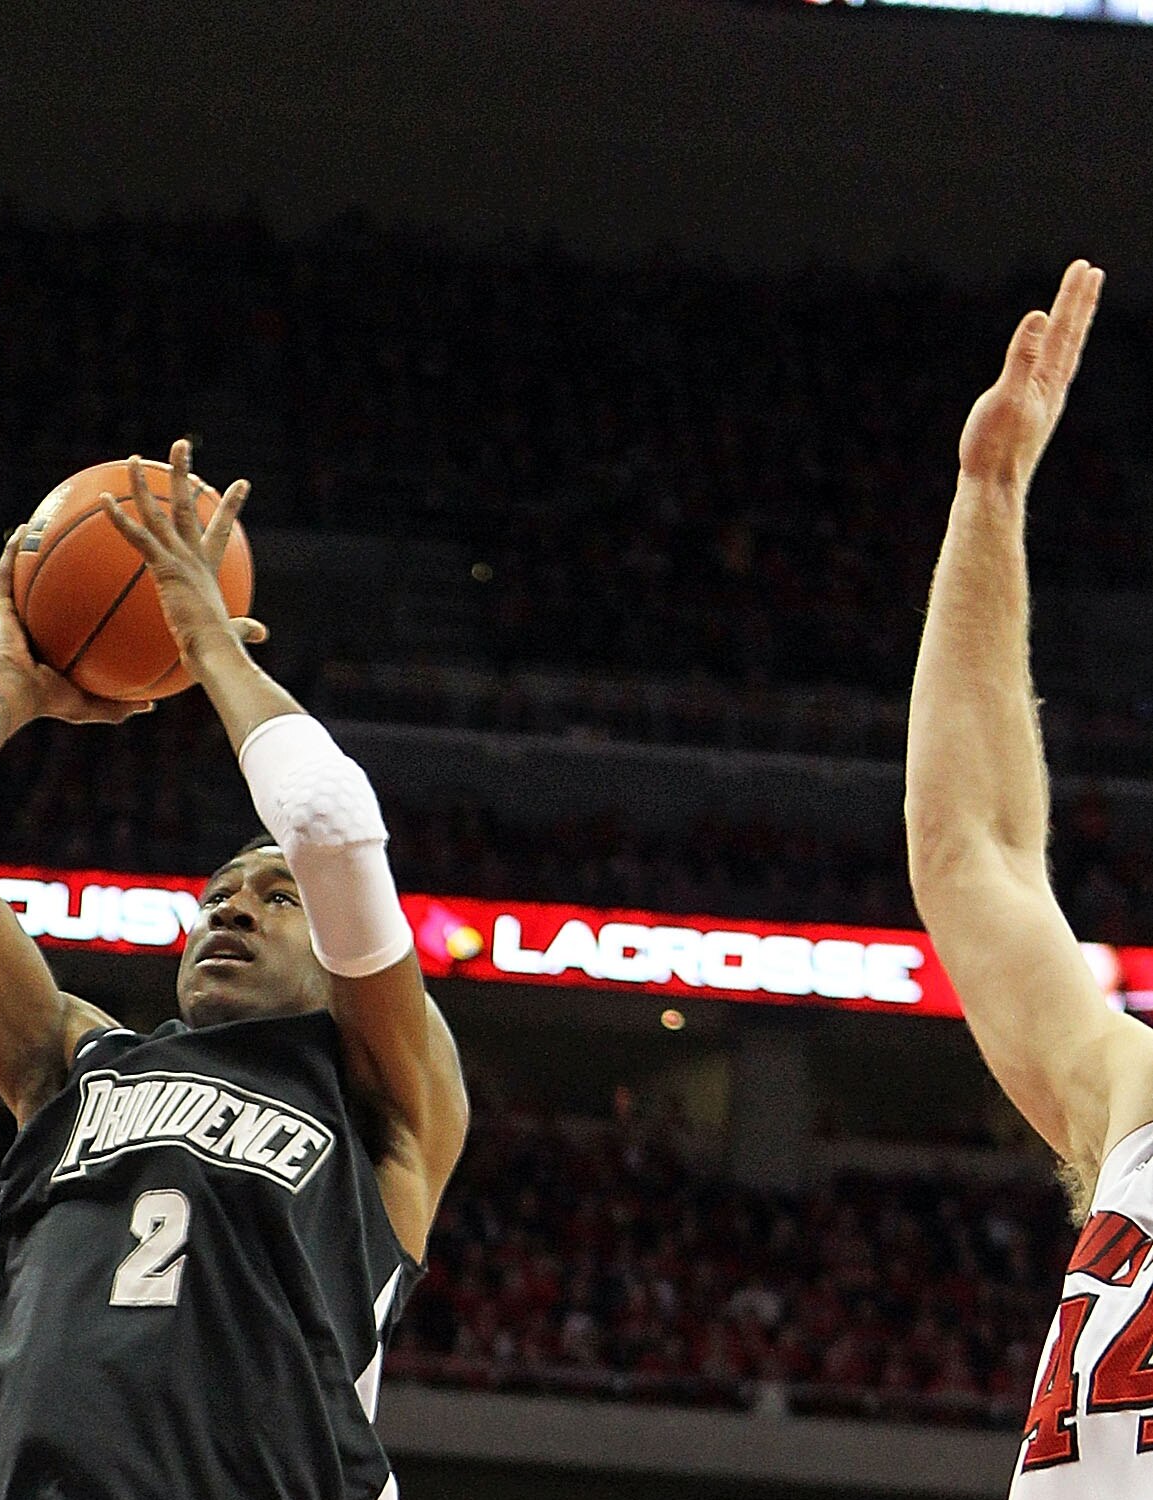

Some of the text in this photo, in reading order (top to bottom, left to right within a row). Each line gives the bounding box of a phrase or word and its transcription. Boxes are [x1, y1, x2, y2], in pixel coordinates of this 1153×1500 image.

[493, 914, 925, 1004] LACROSSE
[53, 1072, 333, 1188] PROVIDENCE
[109, 1188, 192, 1306] 2
